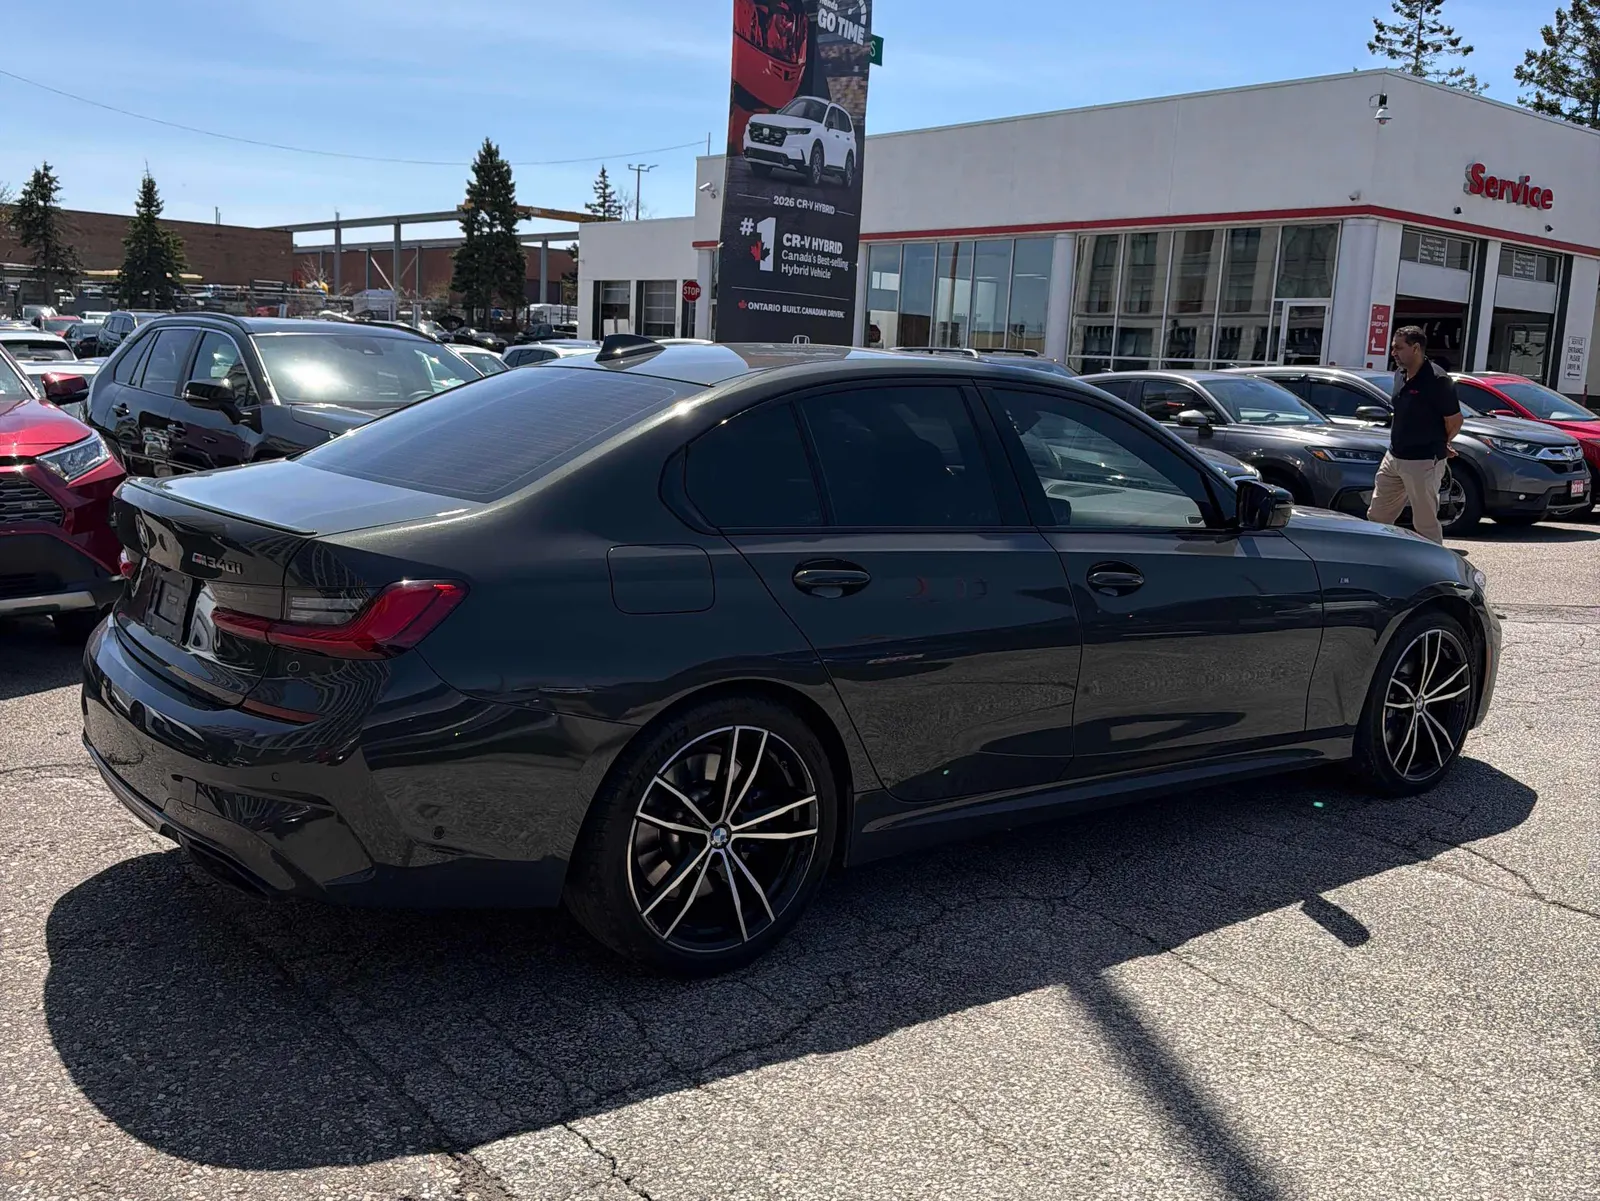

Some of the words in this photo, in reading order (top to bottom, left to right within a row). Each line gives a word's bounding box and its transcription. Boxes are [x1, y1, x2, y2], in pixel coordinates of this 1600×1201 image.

[817, 8, 836, 32] GO
[838, 16, 865, 46] TIME
[1466, 163, 1554, 210] Service
[773, 195, 795, 207] 2026
[796, 199, 814, 210] CR-V
[814, 202, 835, 215] HYBRID
[782, 233, 811, 249] CR-V
[812, 237, 843, 254] HYBRID
[781, 249, 816, 264] Canada's
[817, 254, 849, 272] Best-selling
[781, 263, 809, 277] Hybrid
[683, 286, 700, 296] STOP
[747, 301, 781, 312] ONTARIO
[782, 305, 802, 314] BUILT.
[802, 307, 827, 317] CANADIAN
